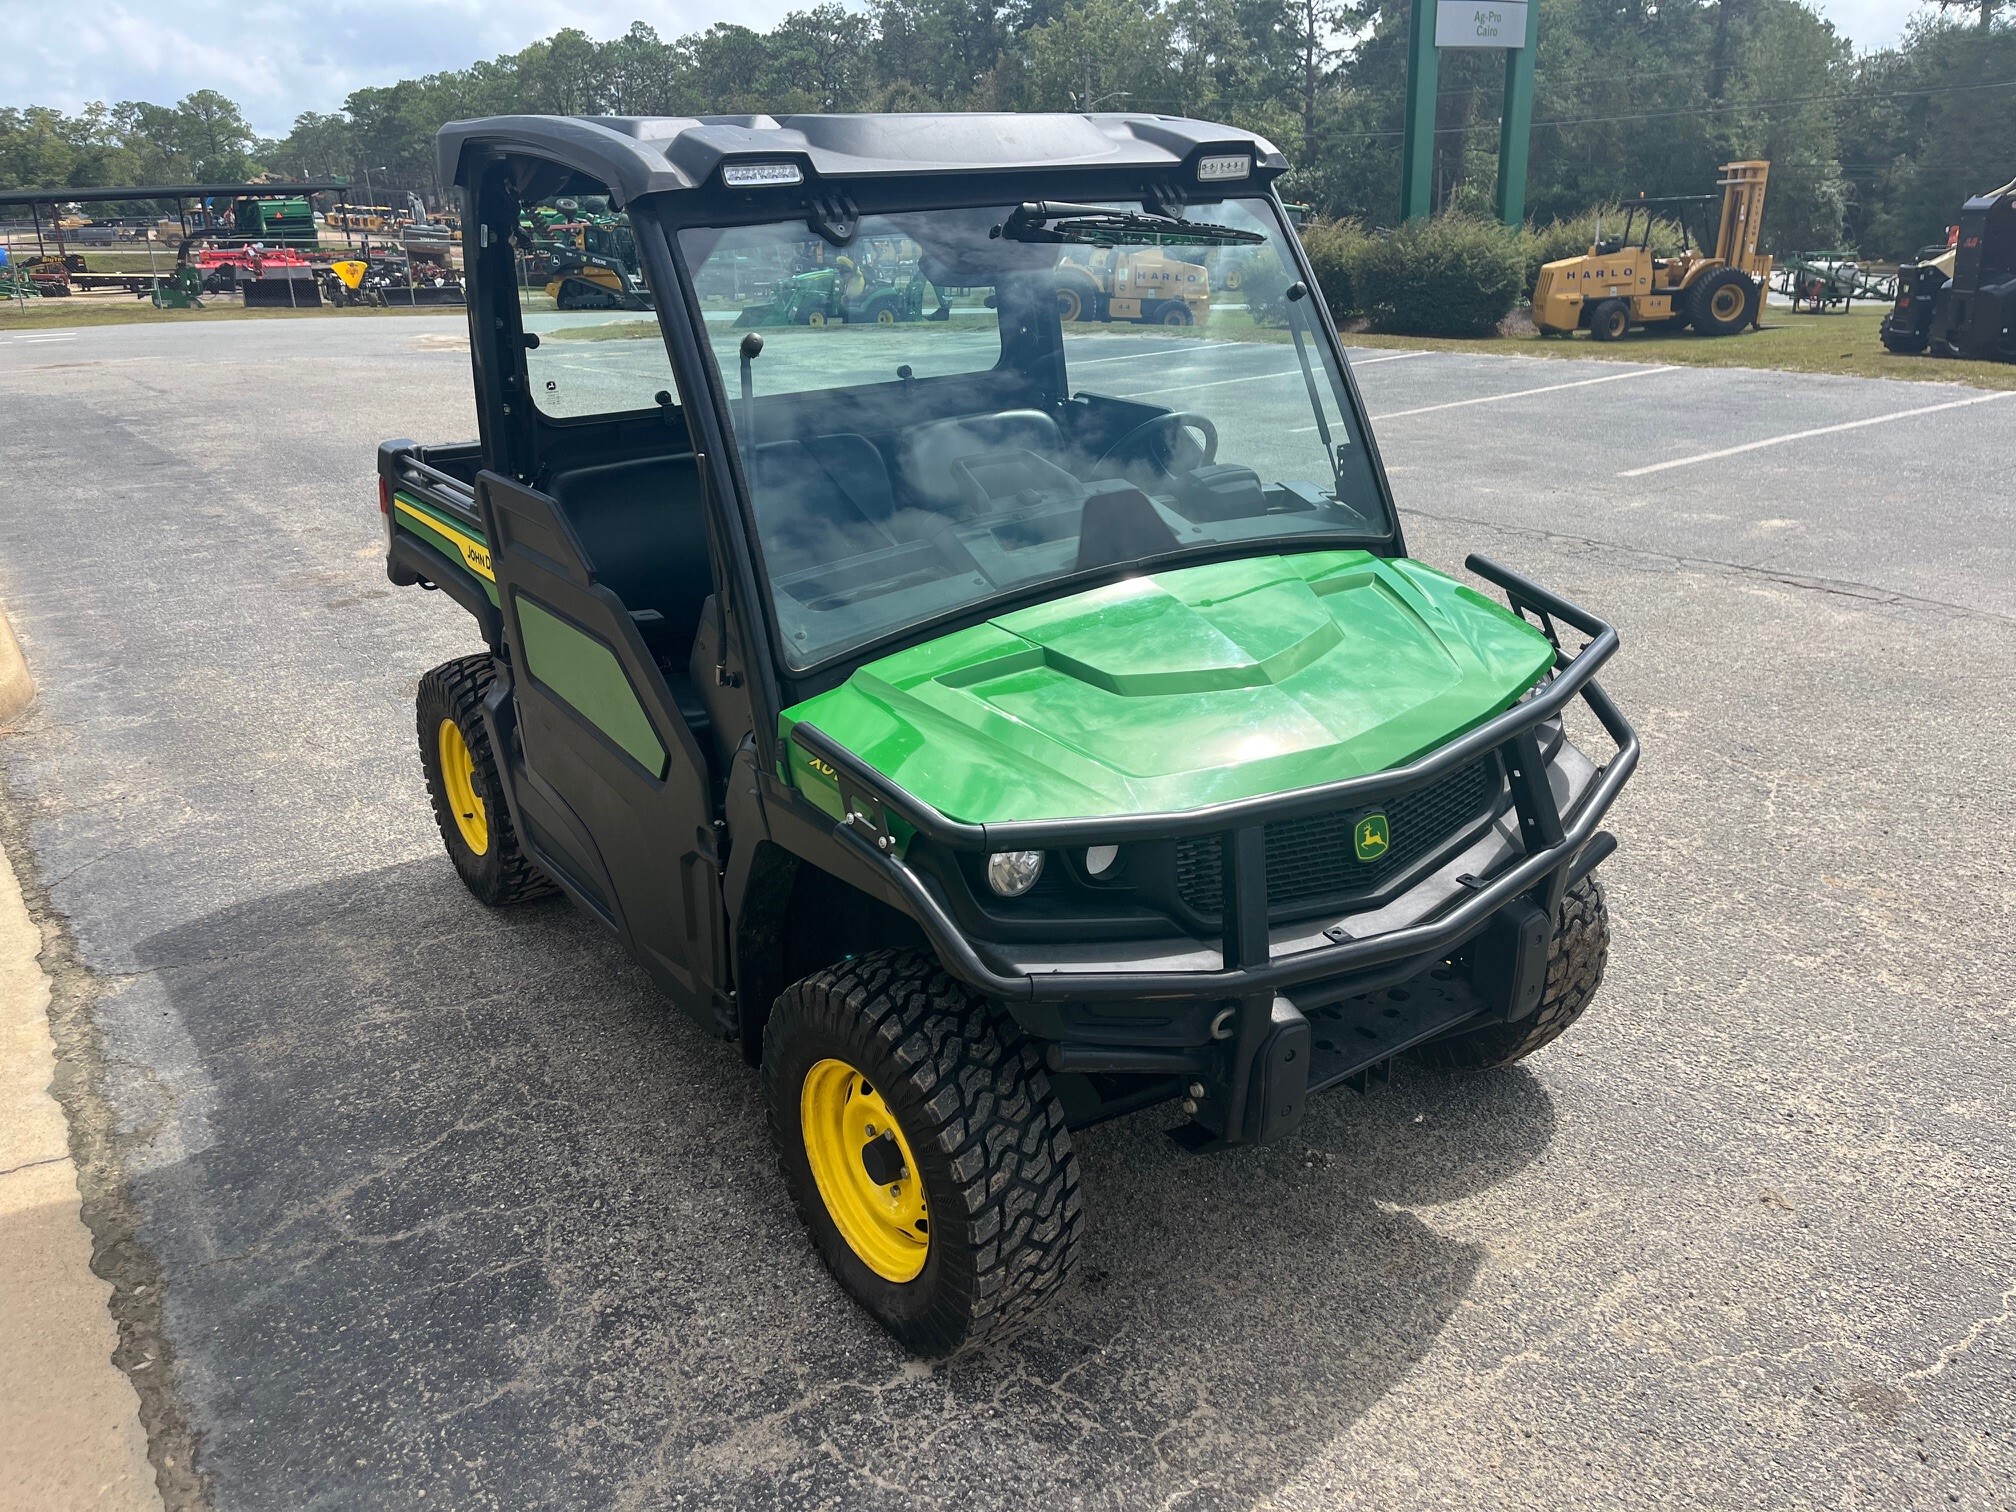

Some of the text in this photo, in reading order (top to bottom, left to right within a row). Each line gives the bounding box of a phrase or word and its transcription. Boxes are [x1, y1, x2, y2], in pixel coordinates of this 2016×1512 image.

[1474, 11, 1502, 24] Ag-Pro
[1476, 25, 1498, 37] Cairo
[592, 257, 607, 266] DEERE
[1137, 271, 1196, 284] HARLO
[1567, 267, 1633, 280] HARLO
[467, 545, 486, 568] JOHN
